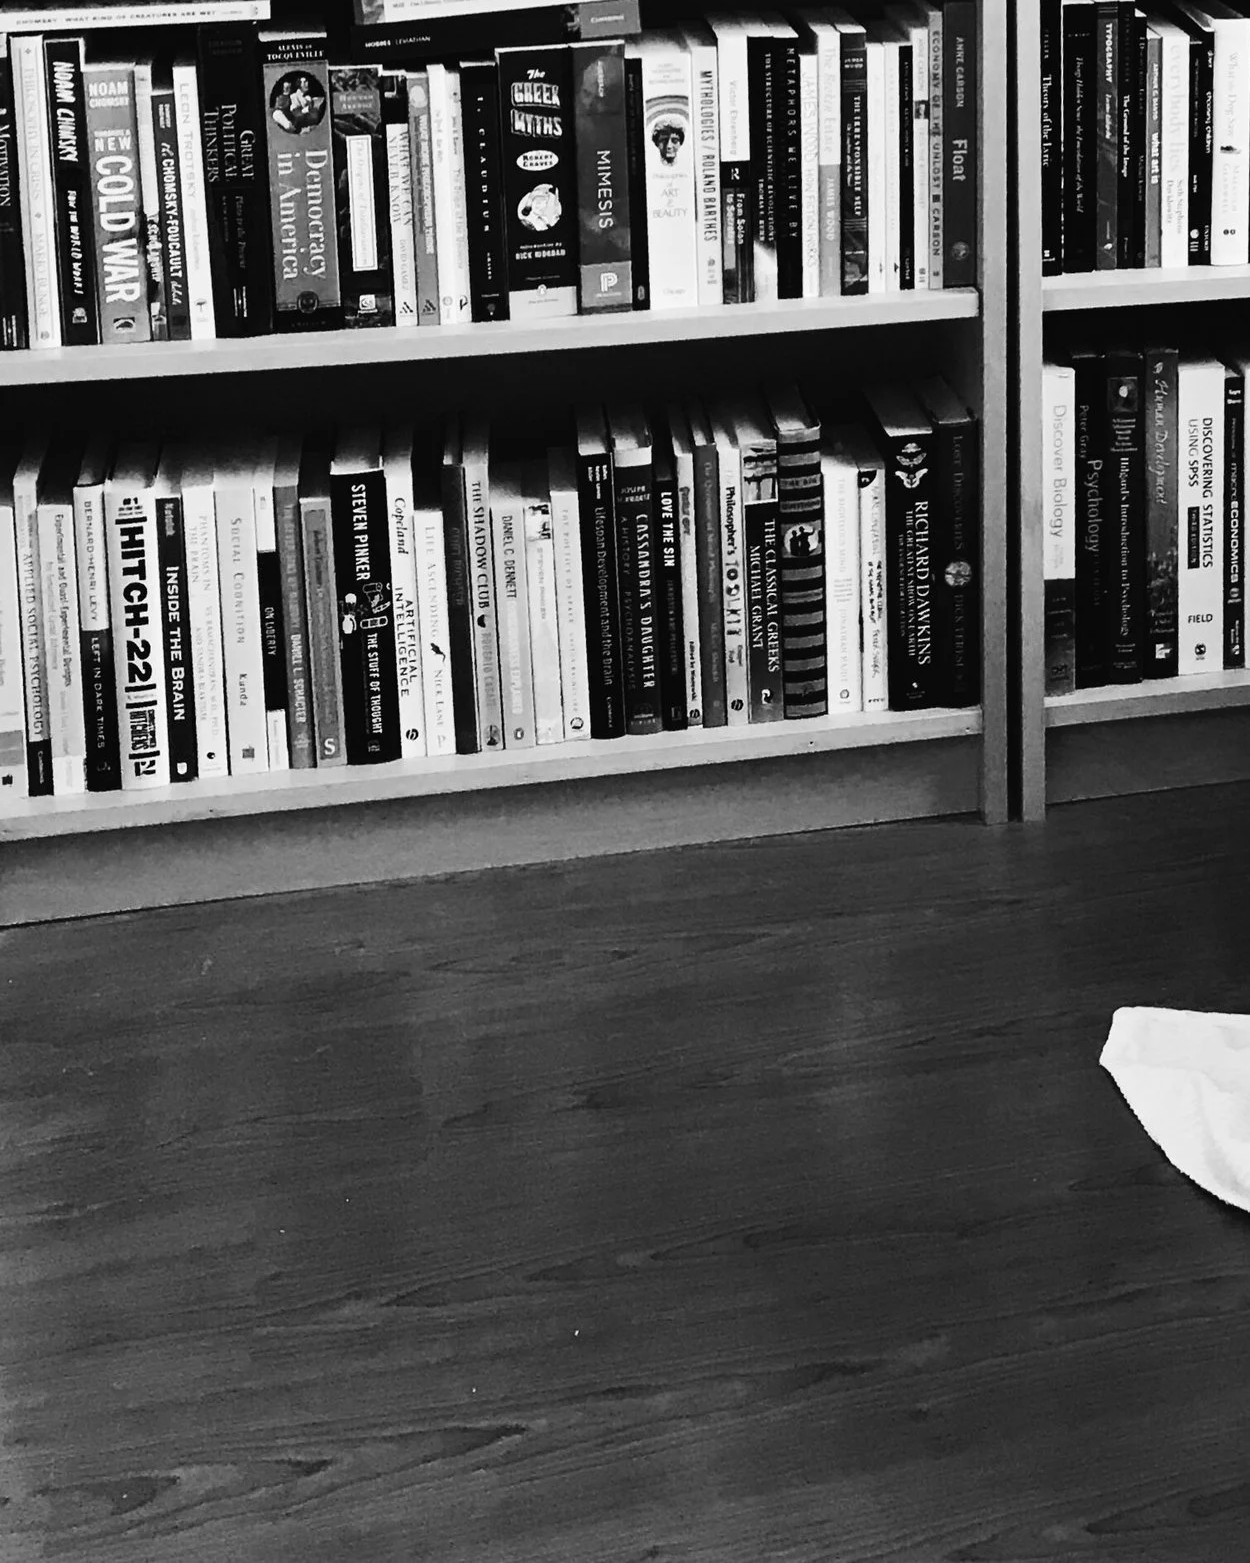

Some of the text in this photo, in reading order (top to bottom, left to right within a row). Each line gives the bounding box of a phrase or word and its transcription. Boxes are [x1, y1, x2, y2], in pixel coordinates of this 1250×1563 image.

[511, 82, 560, 107] GREEK
[527, 69, 545, 79] The
[1104, 23, 1112, 82] TYPOGRAPHY
[54, 62, 78, 162] NOAM CHOMSKY
[510, 110, 562, 137] MYTHS
[700, 70, 717, 241] MYTHOLOGIES ROLAND BARTHES
[952, 139, 968, 181] Float
[96, 155, 140, 303] COLD WAR
[163, 158, 181, 278] CHOMSKY-FOUCAULT
[277, 153, 303, 281] in America
[303, 149, 328, 279] Democracy
[597, 150, 612, 228] MIMESIS
[1050, 404, 1067, 537] Discover Biology
[1188, 418, 1199, 488] USING SPSS
[1202, 417, 1213, 568] DISCOVERING STATISTICS
[351, 484, 371, 580] STEVEN PINKER
[394, 498, 409, 554] Copeland
[661, 491, 675, 566] LOVE THE SIN
[1086, 459, 1102, 552] Psychology
[122, 525, 151, 682] HITCH-22
[750, 546, 763, 649] MICHAEL GRANT
[764, 519, 781, 673] THE CLASSICAL GREEKS
[914, 501, 931, 665] RICHARD DAWKINS
[170, 628, 182, 659] THE
[368, 633, 383, 734] THE STUFF OF THOUGHT
[394, 588, 410, 697] INTELLIGENCE
[405, 599, 417, 682] ARTIFICIAL
